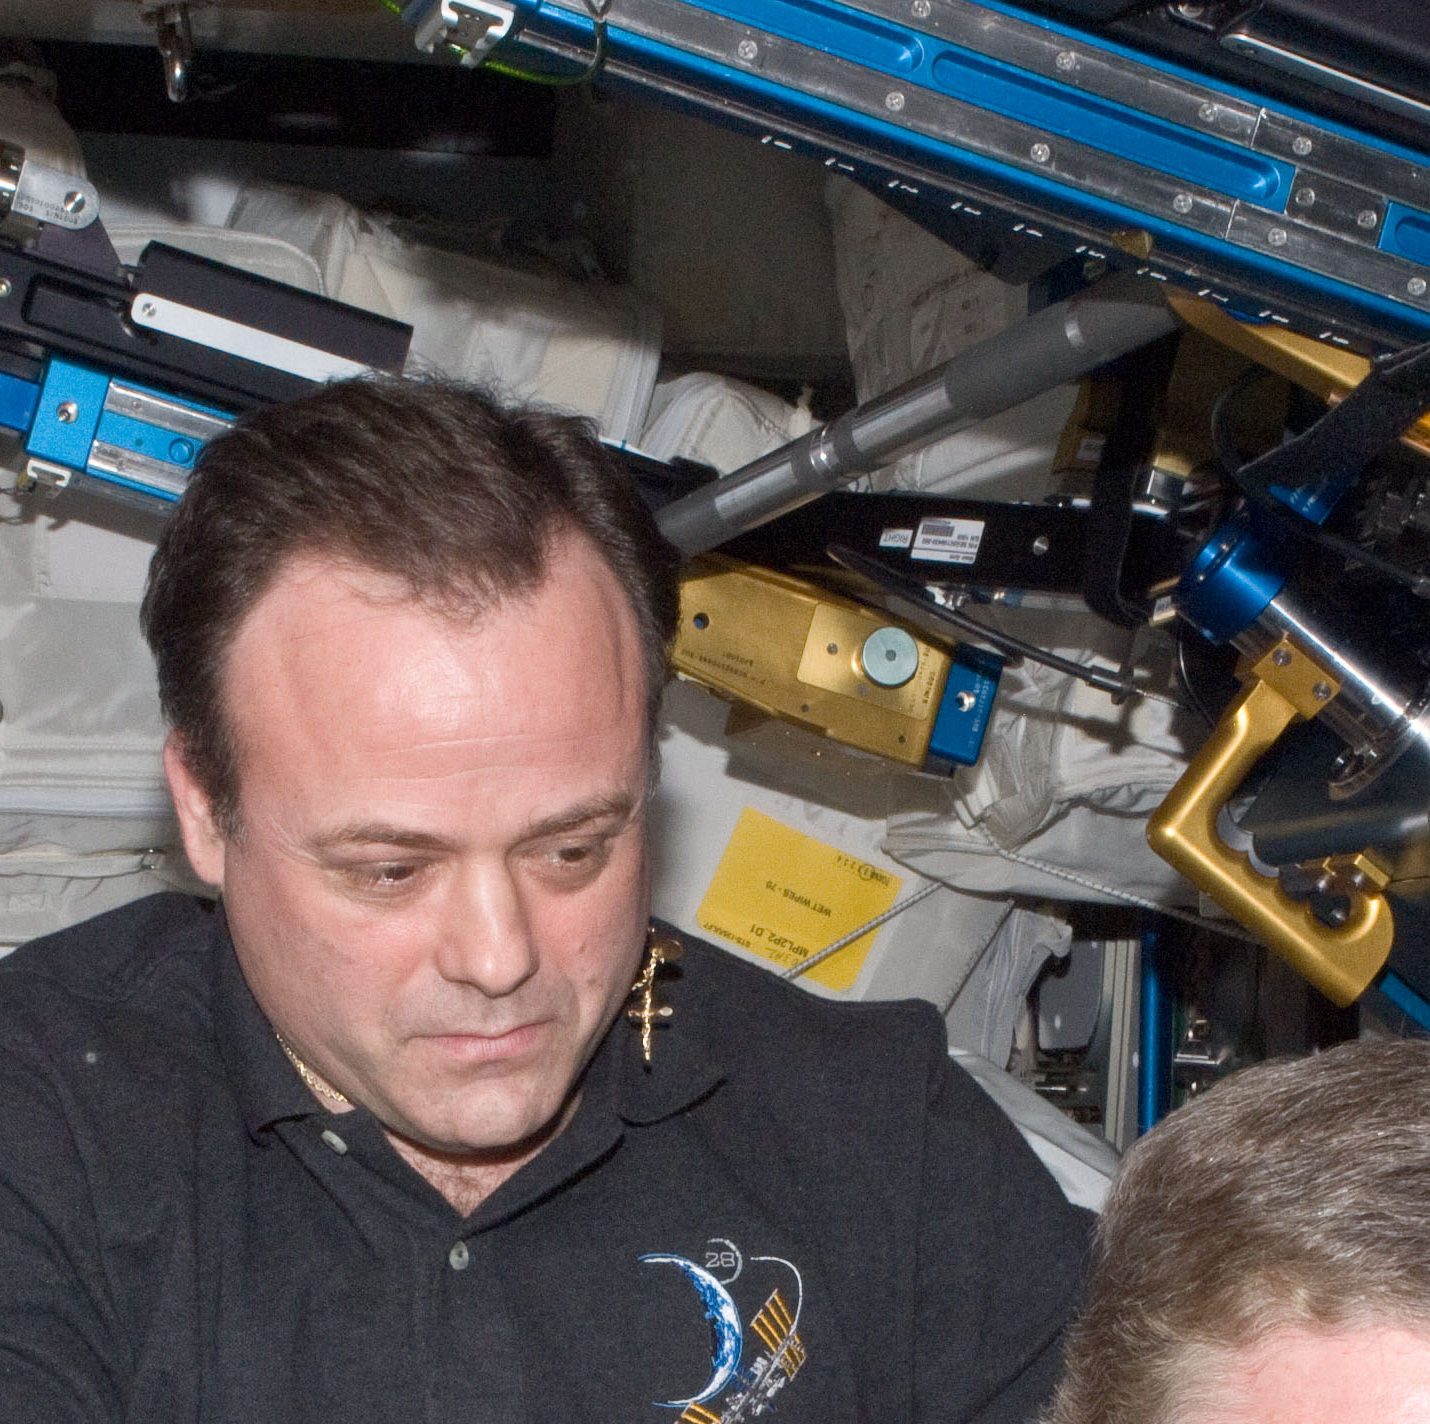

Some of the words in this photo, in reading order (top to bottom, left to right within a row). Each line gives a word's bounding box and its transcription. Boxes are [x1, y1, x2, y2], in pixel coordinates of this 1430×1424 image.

[883, 533, 909, 544] RIGHT
[765, 880, 778, 893] 70
[782, 888, 810, 910] WIPES
[810, 901, 832, 918] WET
[705, 1252, 736, 1268] 28
